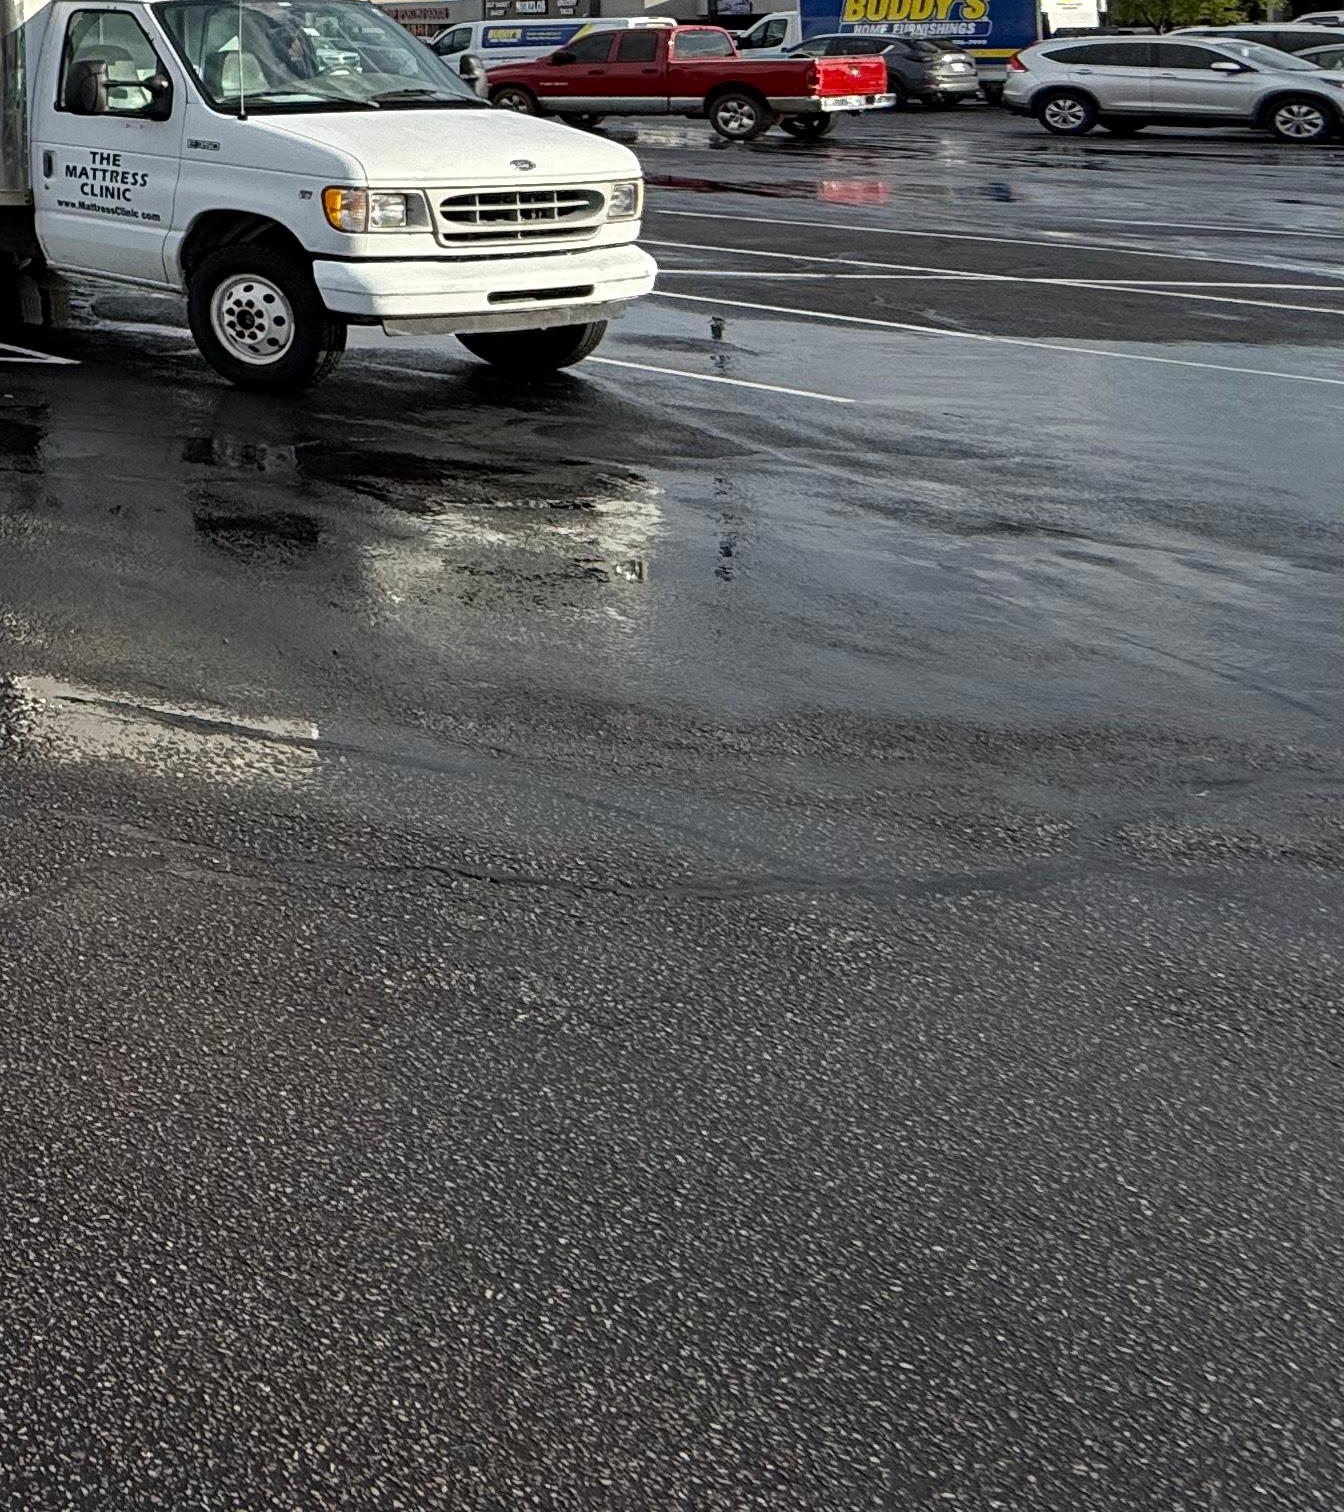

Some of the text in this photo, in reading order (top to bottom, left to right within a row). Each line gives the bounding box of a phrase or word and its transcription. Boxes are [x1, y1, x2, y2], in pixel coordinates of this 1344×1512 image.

[853, 22, 976, 36] HOME FURNISHINGS
[89, 151, 123, 168] THE
[65, 165, 149, 187] MATTRESS
[80, 183, 132, 202] CLINIC
